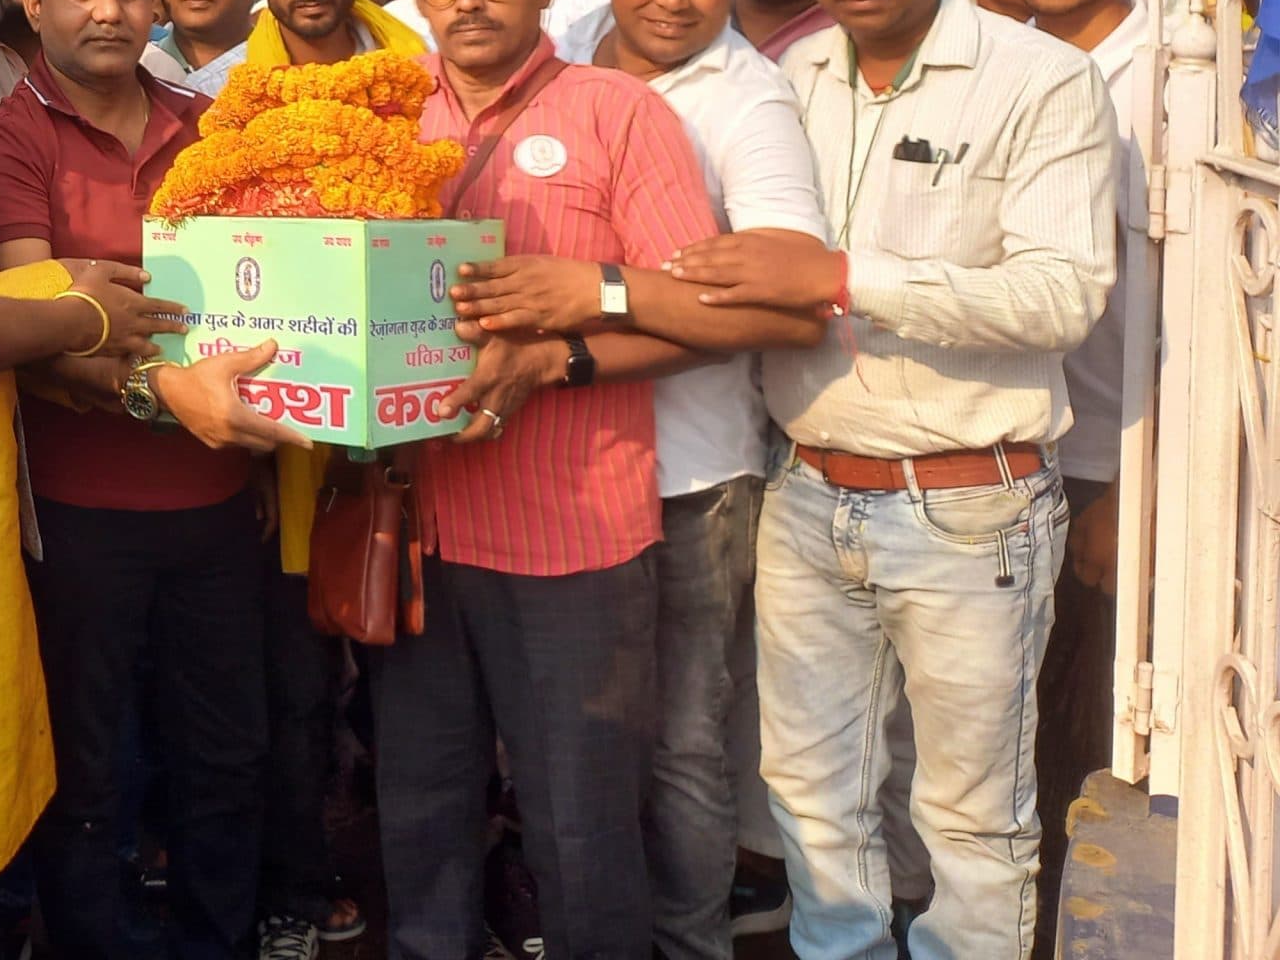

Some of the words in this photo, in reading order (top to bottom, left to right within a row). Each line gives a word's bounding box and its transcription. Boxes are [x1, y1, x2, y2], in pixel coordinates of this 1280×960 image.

[205, 314, 228, 331] युद्ध
[232, 311, 245, 328] के
[249, 317, 284, 331] अमर
[288, 315, 335, 335] शहीदों
[337, 318, 357, 336] की
[410, 320, 426, 338] युद्ध
[428, 315, 438, 331] के
[406, 344, 443, 367] पवित्र
[448, 346, 471, 362] रज
